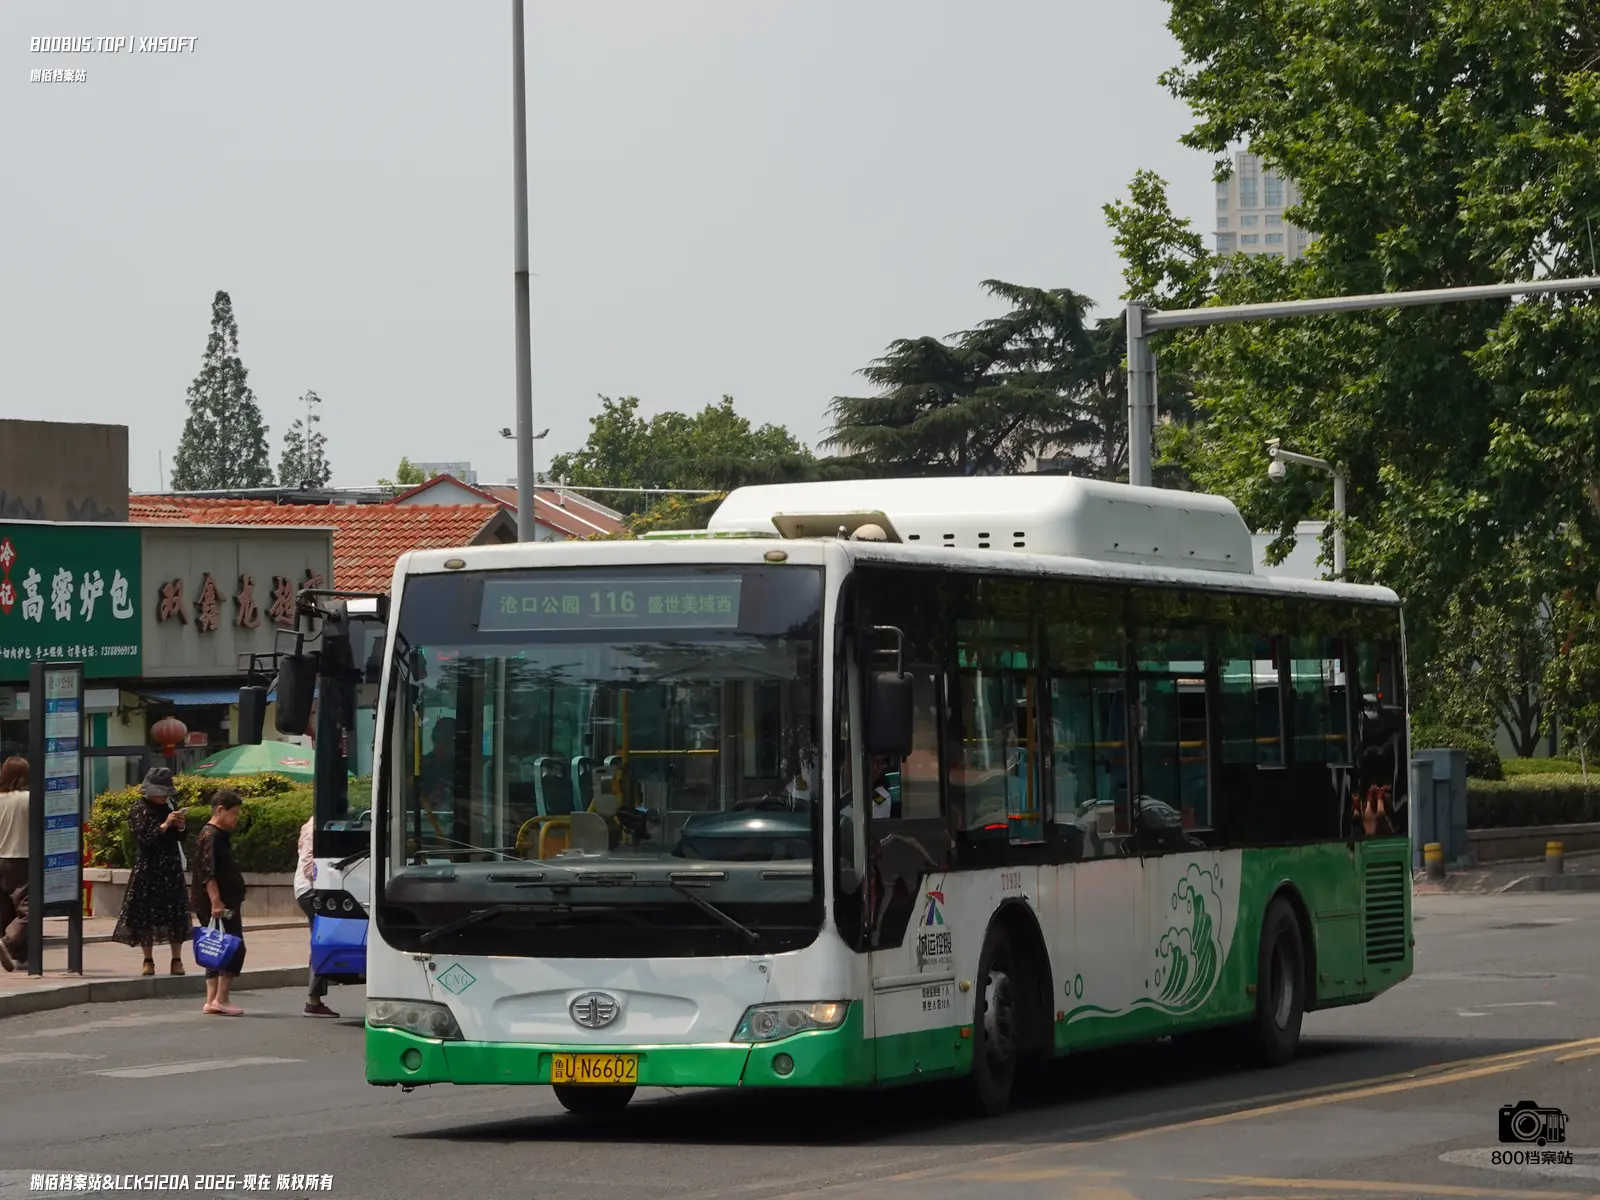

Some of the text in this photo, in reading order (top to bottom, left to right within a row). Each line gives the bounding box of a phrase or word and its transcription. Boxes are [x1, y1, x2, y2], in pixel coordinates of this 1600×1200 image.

[22, 566, 134, 623] 高密炉包
[500, 594, 580, 614] 沧口公园
[590, 589, 635, 613] 116
[918, 931, 952, 957] 城运控股
[444, 969, 468, 985] CNG
